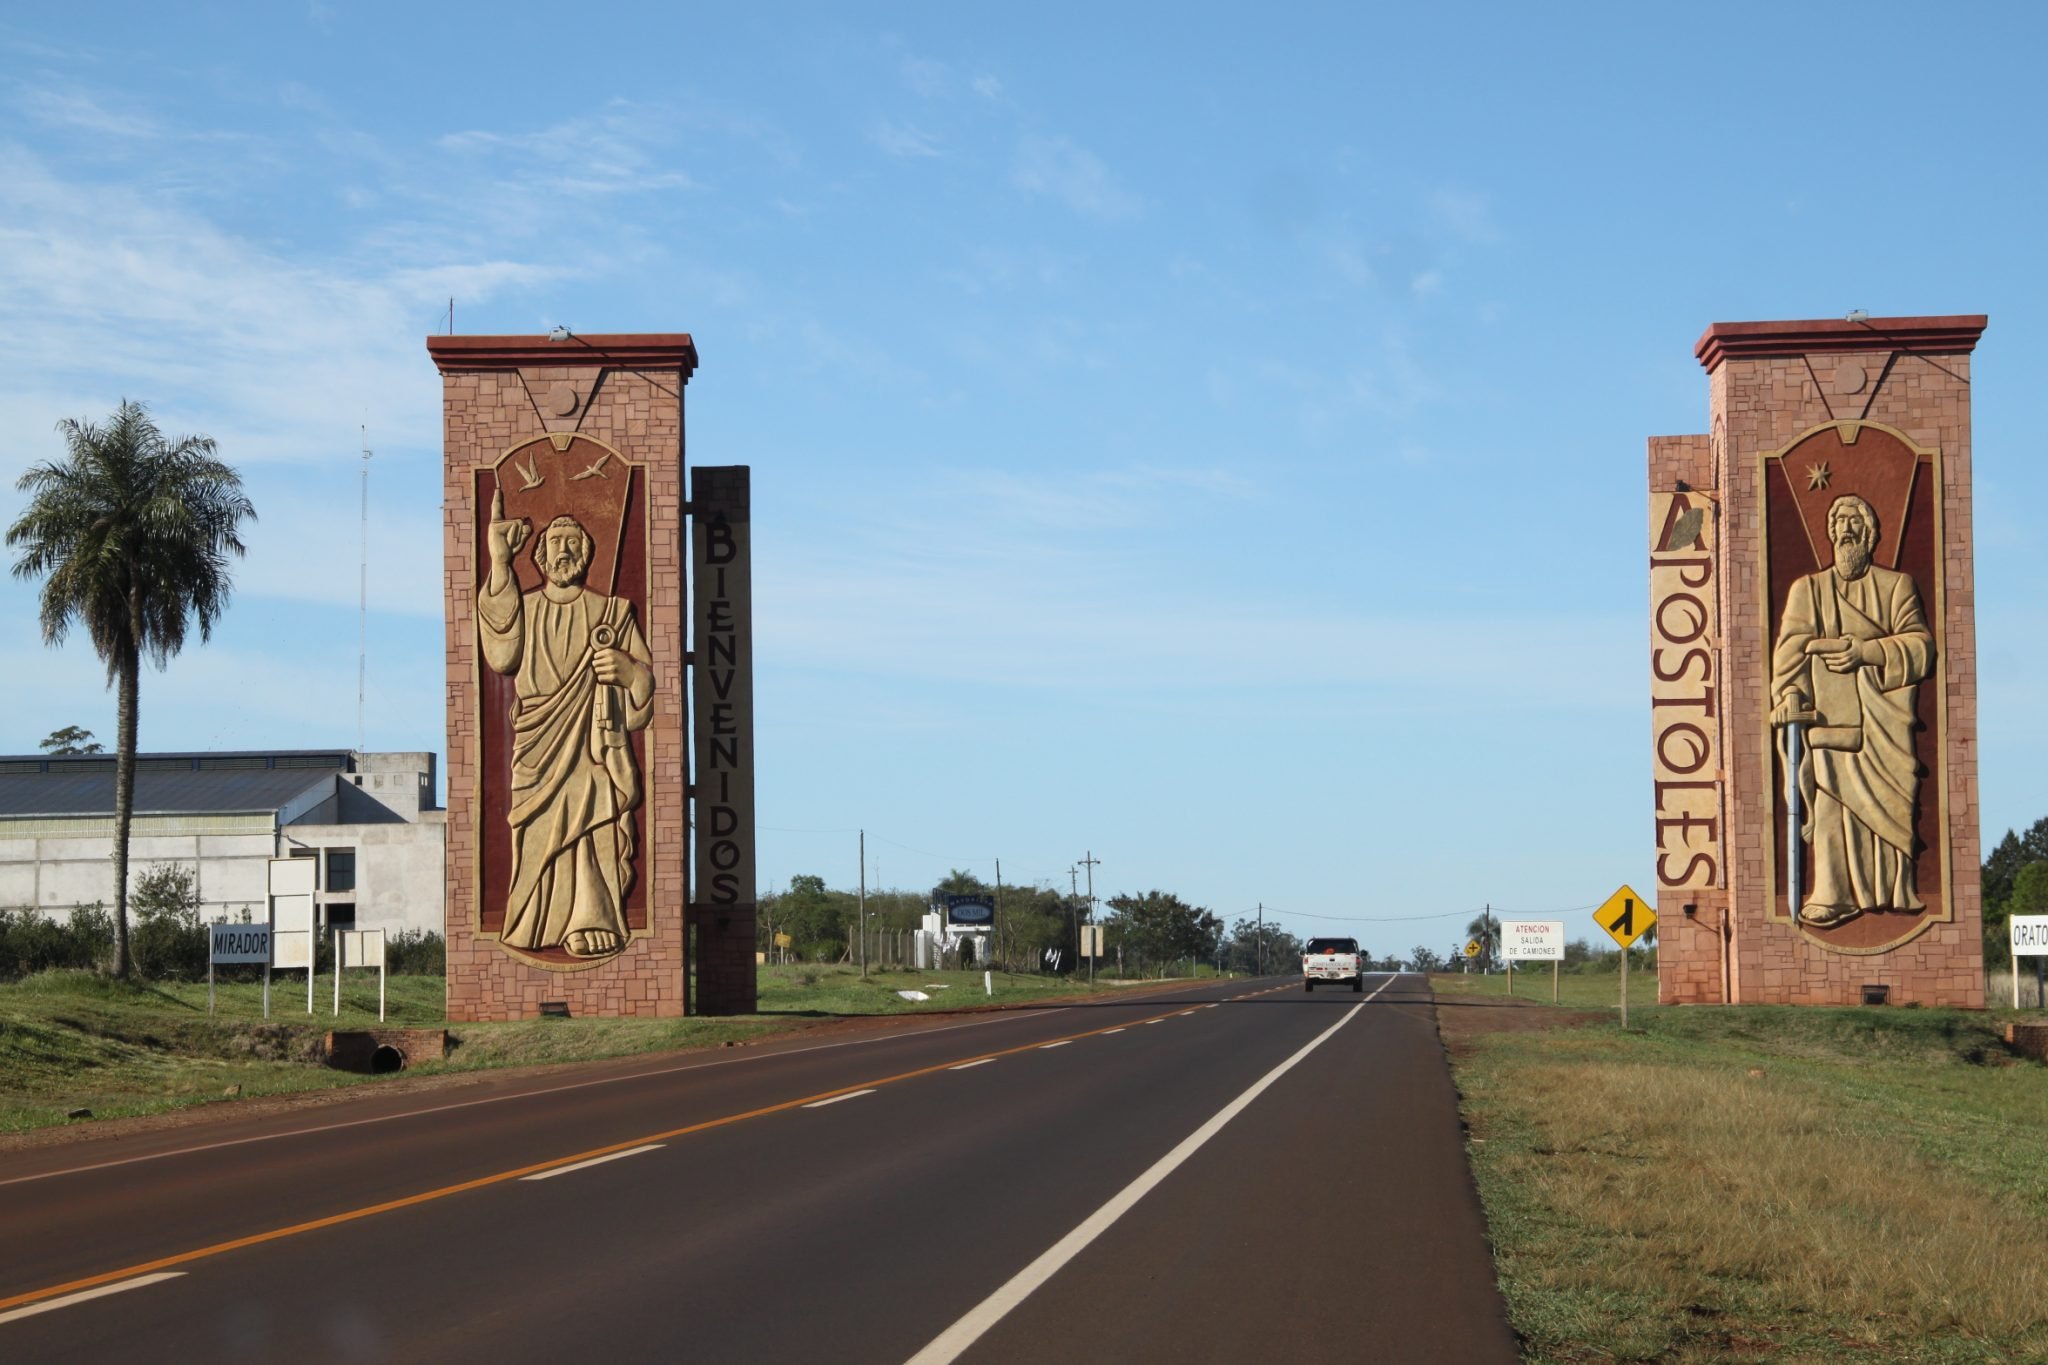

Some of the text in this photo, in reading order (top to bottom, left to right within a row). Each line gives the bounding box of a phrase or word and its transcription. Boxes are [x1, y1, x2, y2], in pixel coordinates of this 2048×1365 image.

[704, 522, 740, 905] BIENVENIDOS
[1515, 925, 1550, 934] ATENCION
[213, 932, 268, 954] MIRADOR
[1521, 936, 1544, 945] SALIDA
[1509, 947, 1556, 955] DE CAMIONES
